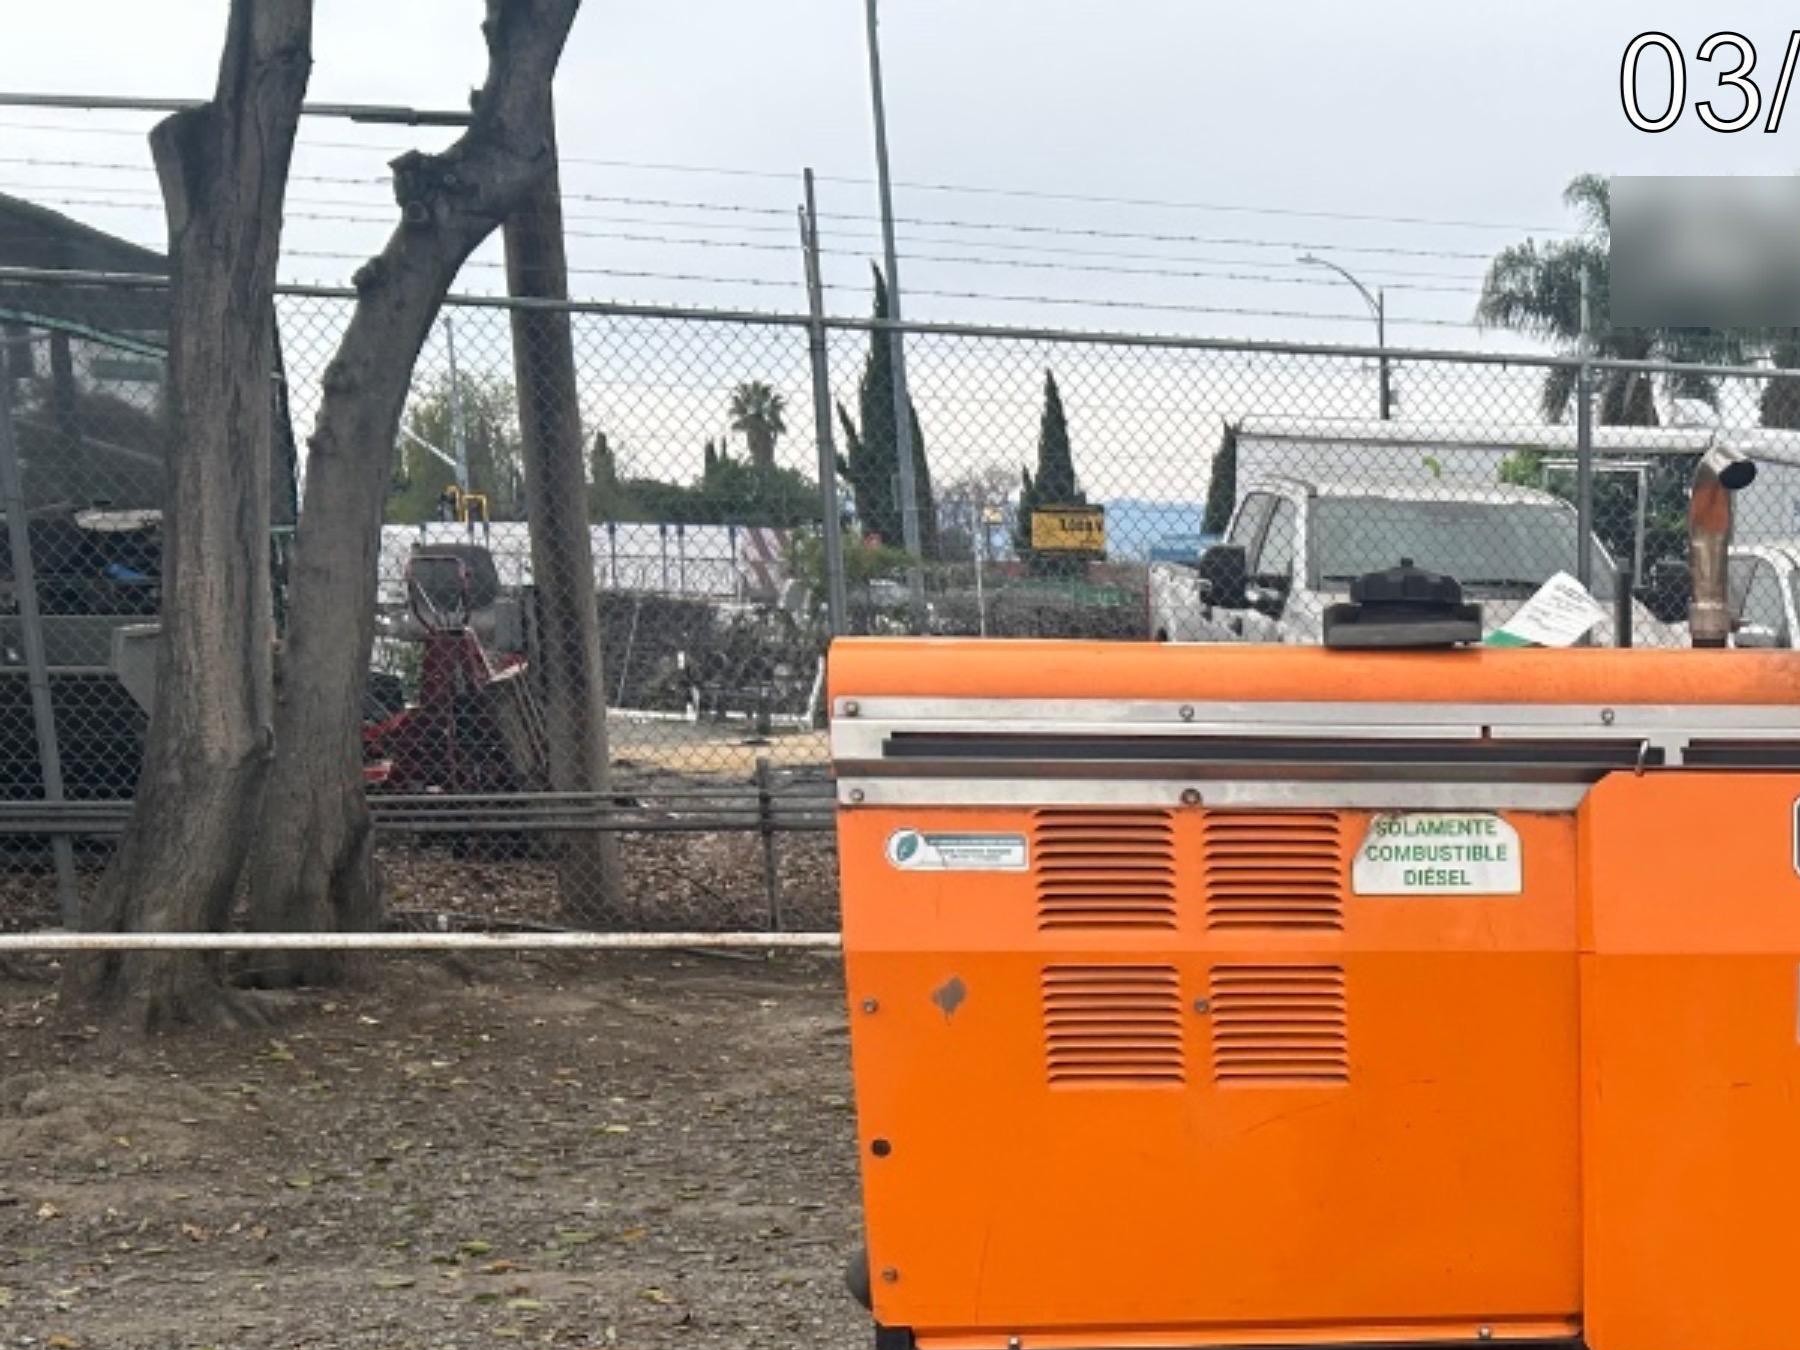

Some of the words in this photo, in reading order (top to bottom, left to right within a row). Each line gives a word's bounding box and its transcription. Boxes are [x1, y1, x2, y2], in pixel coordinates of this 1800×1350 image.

[1375, 818, 1498, 838] SOLAMENTE
[1365, 844, 1508, 862] COMBUSTIBLE
[1403, 866, 1472, 886] DIÉSEL
